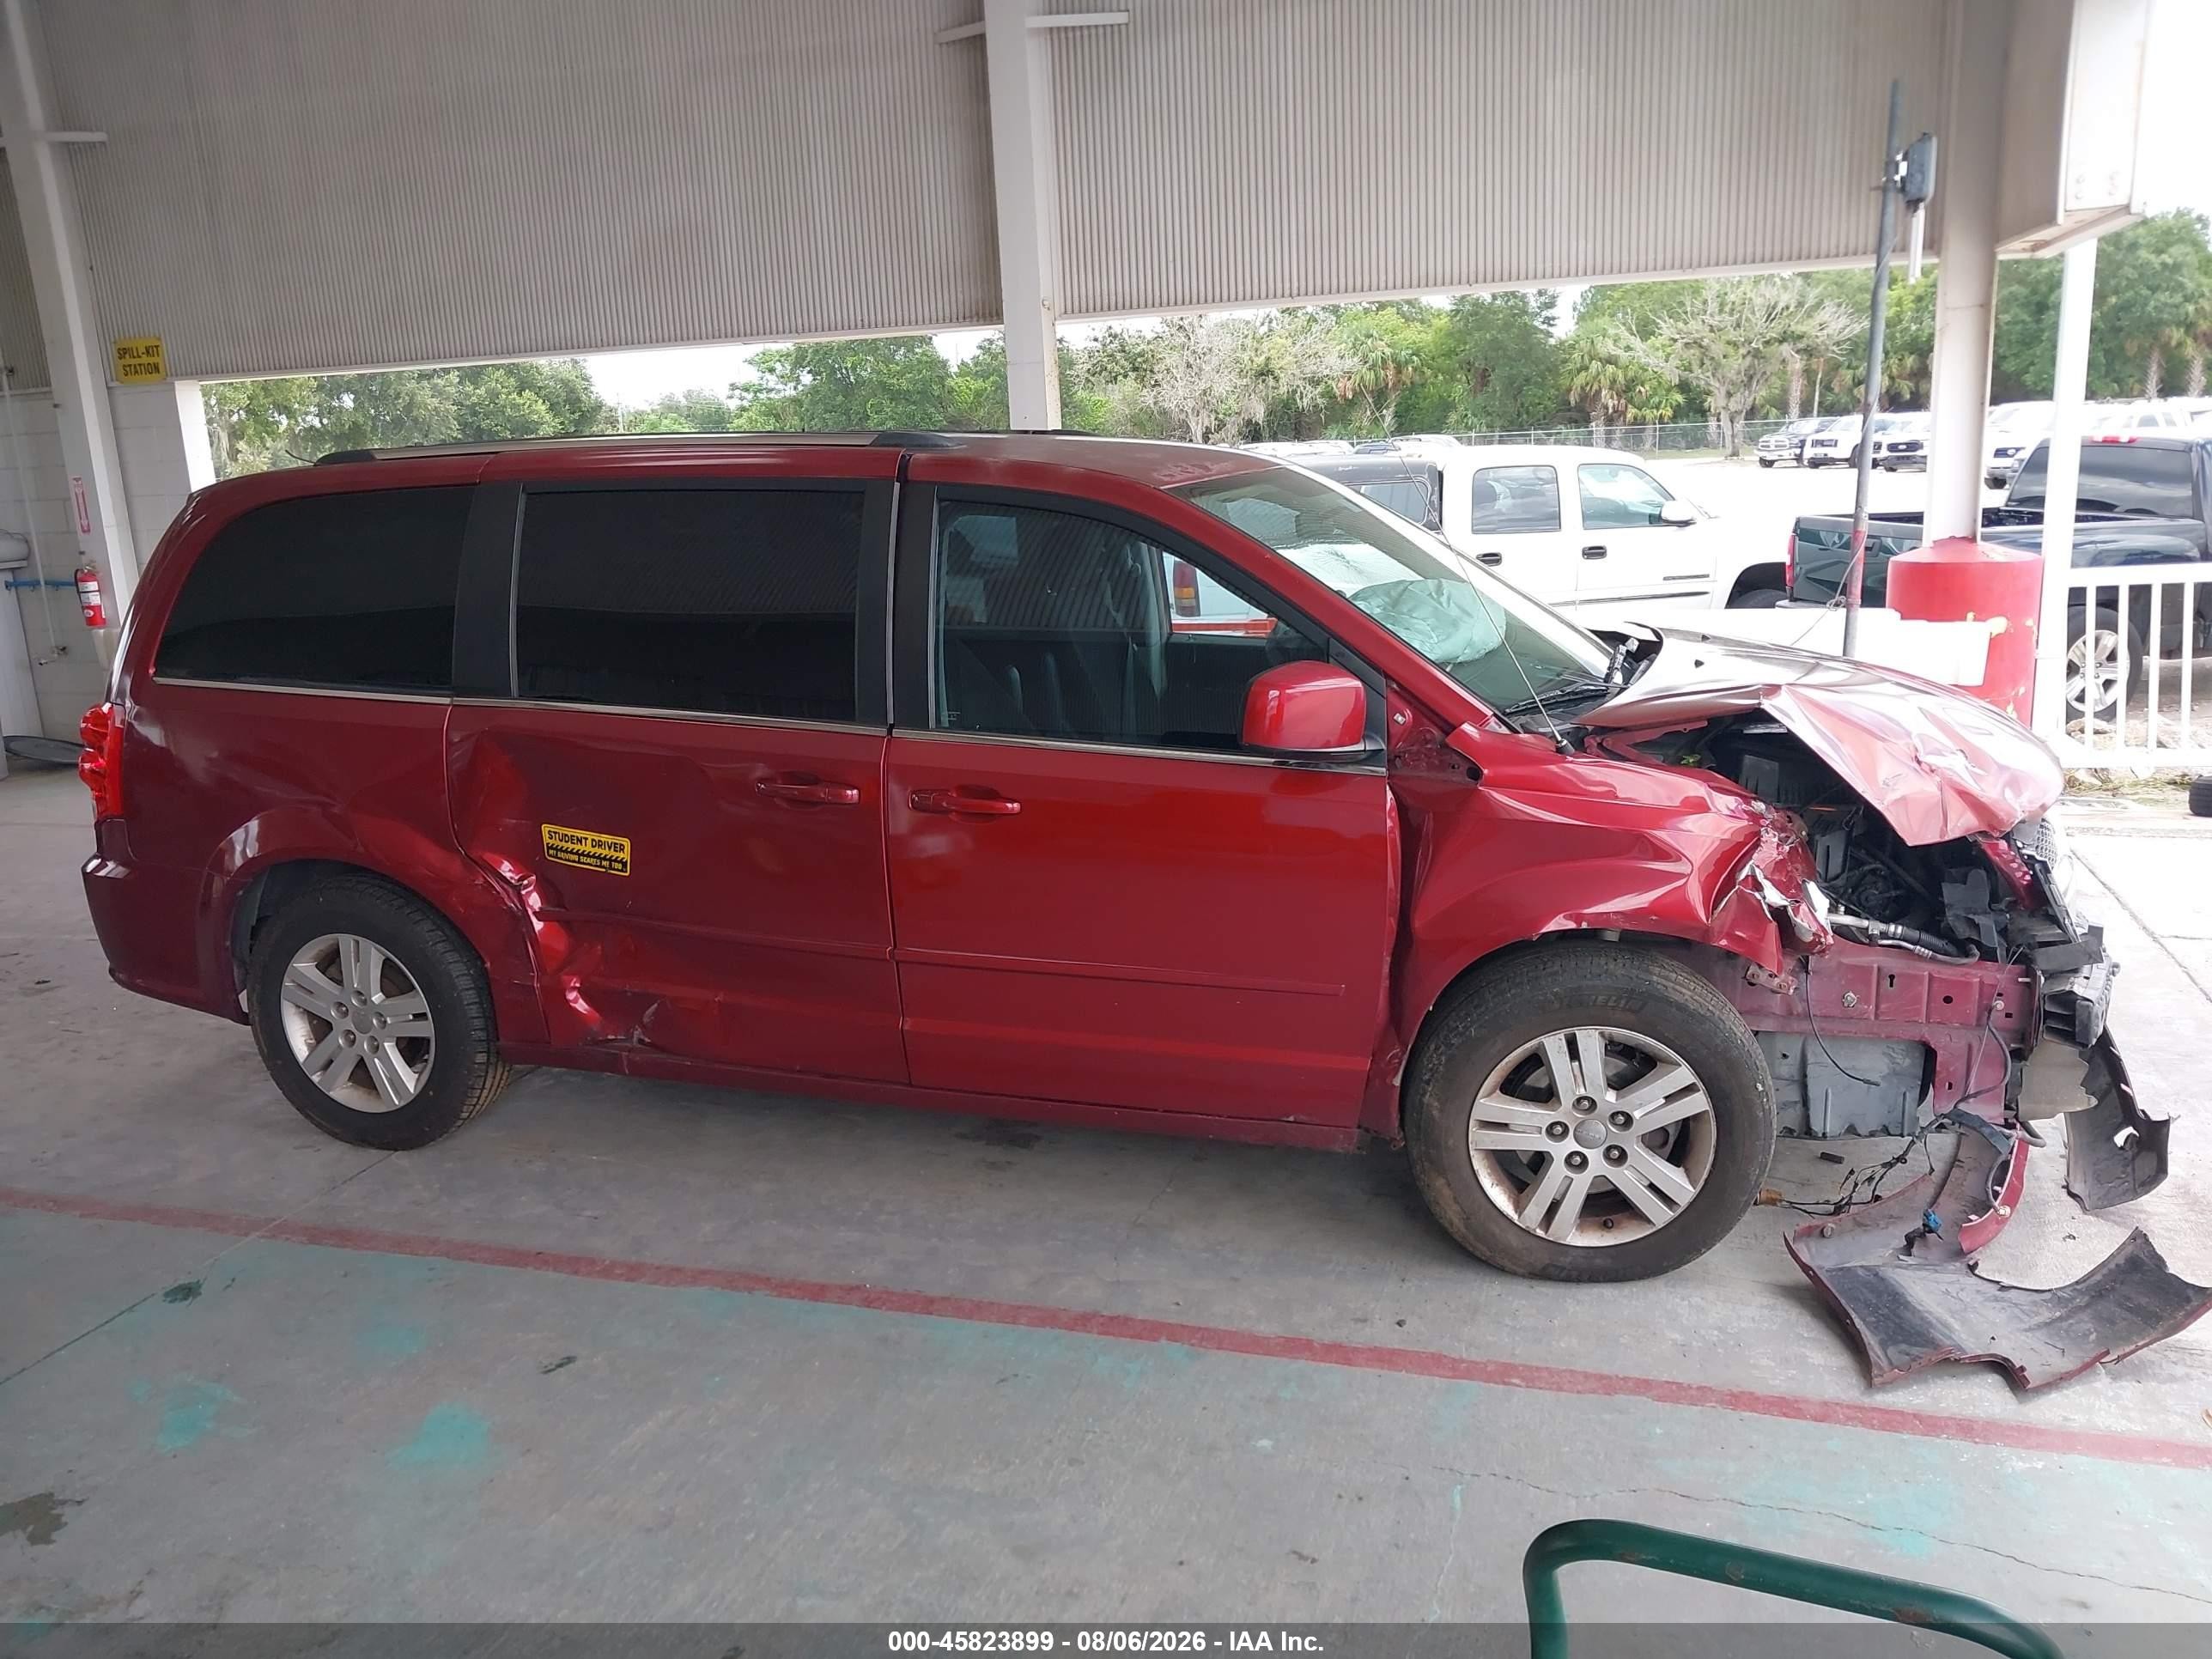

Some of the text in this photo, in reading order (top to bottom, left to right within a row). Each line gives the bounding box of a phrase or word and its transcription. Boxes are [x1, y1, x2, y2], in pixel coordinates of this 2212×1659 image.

[117, 344, 161, 360] SPILL-KIT
[122, 362, 161, 377] STATION
[548, 830, 625, 854] STUDENT DRIVER
[549, 848, 556, 857] MY
[580, 856, 600, 866] SCARES
[601, 860, 610, 868] ME
[611, 861, 623, 870] TOO
